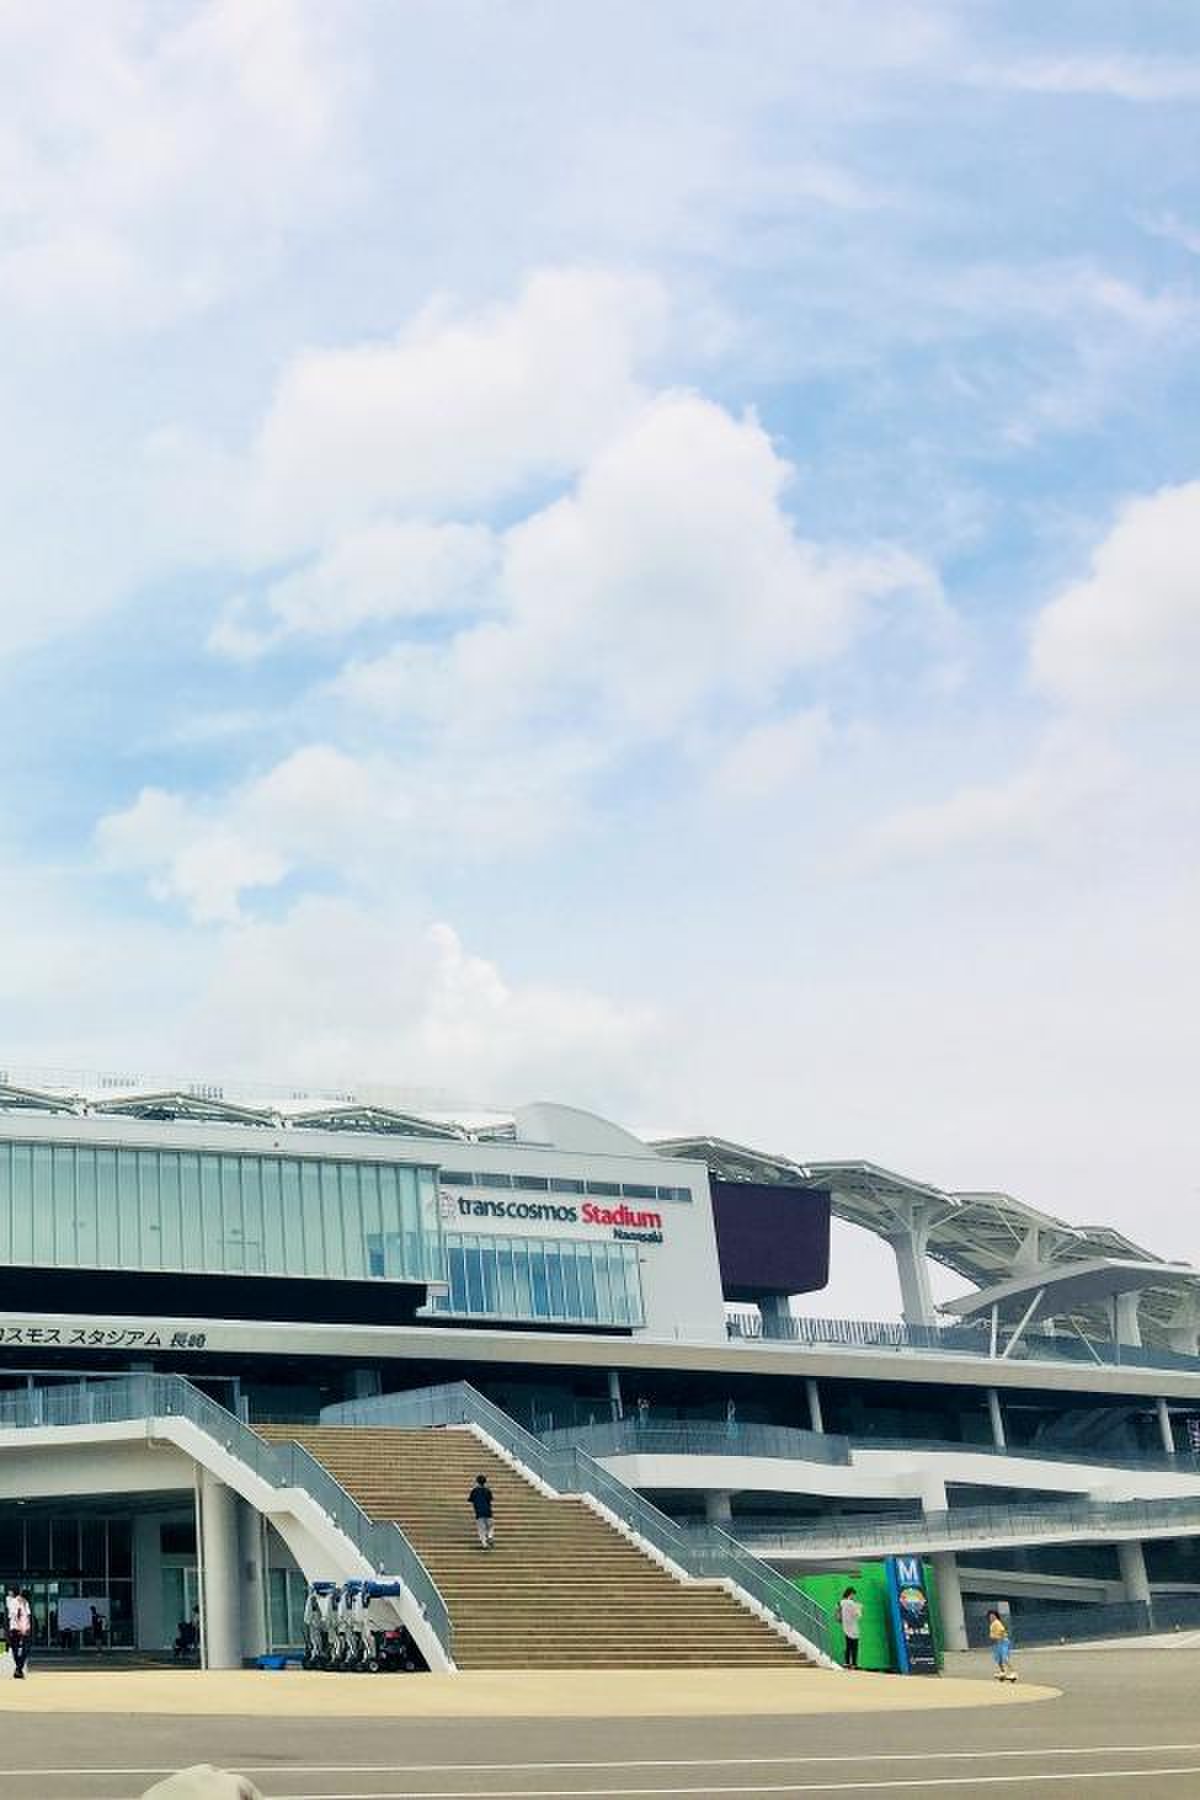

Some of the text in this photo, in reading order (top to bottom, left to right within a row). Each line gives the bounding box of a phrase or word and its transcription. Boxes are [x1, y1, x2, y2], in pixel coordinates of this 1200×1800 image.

[458, 1196, 662, 1228] transcosmos Stadium
[69, 1328, 161, 1347] スタジアム
[897, 1559, 920, 1584] M
